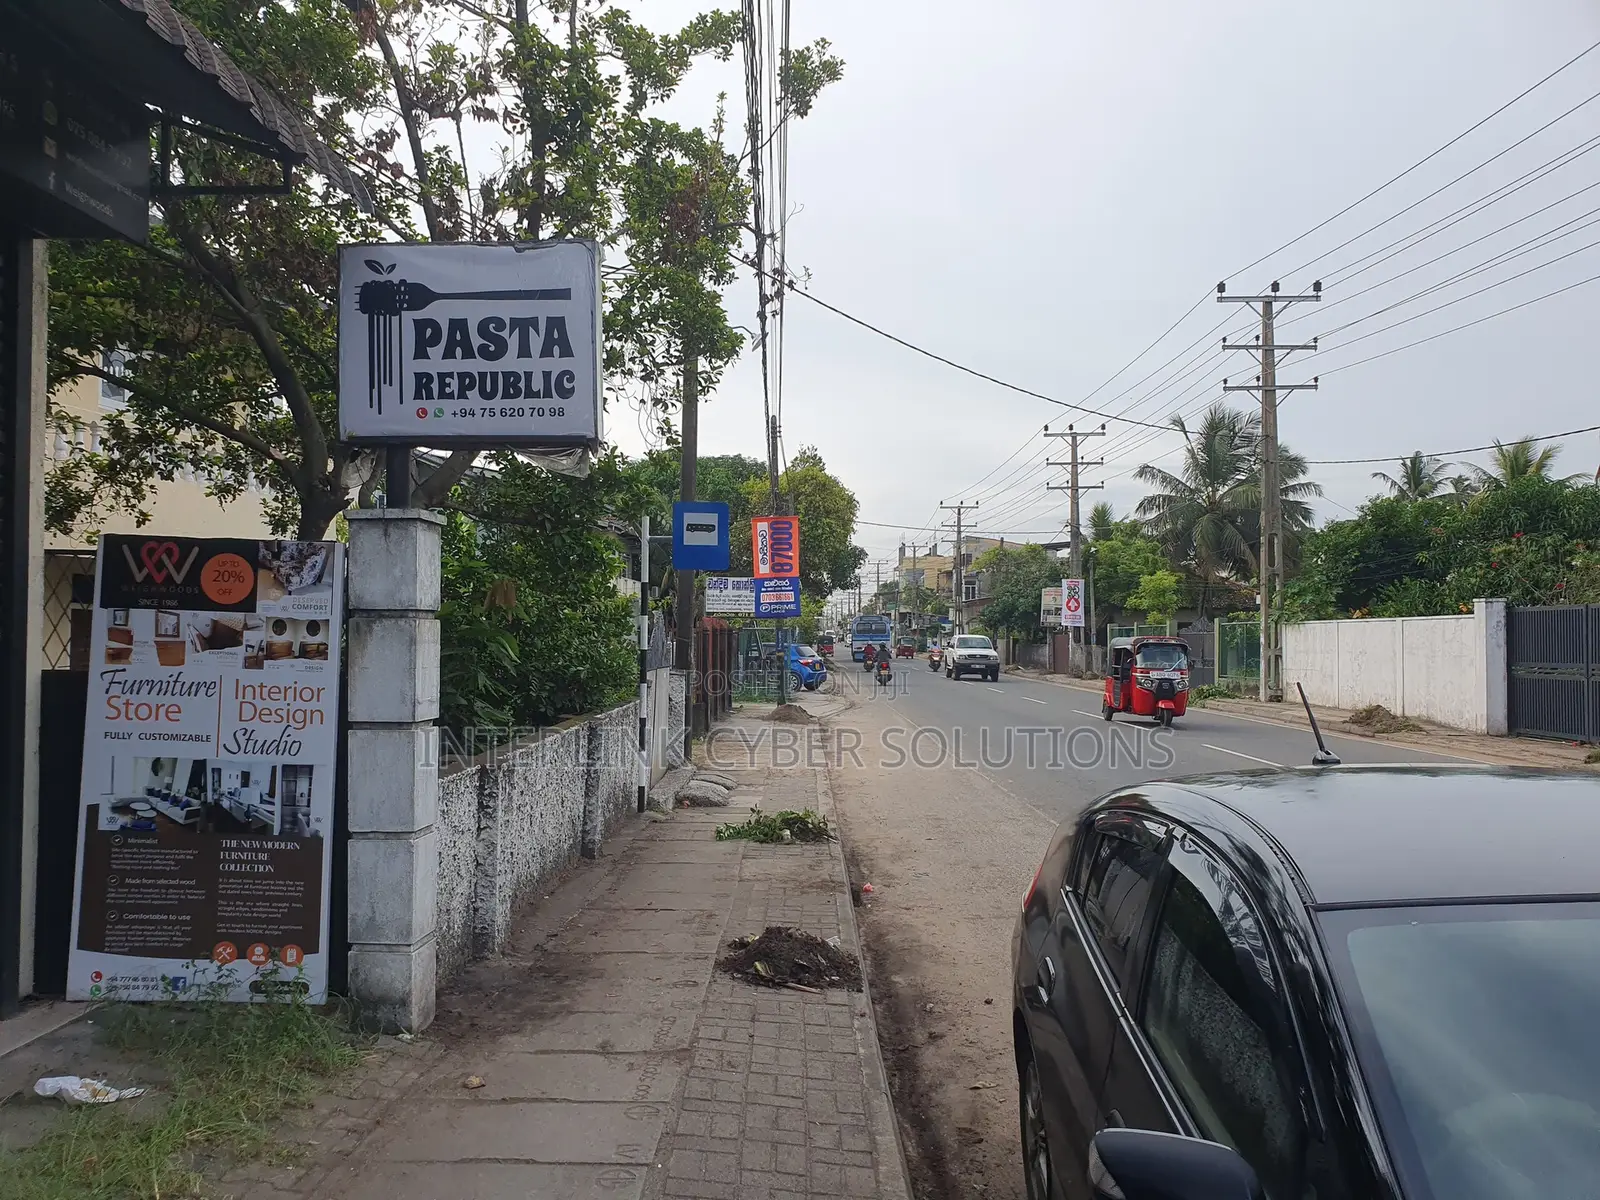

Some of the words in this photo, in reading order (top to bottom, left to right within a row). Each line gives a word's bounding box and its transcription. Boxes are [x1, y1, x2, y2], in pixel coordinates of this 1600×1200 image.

[412, 316, 575, 361] PASTA
[412, 369, 576, 401] REPUBLIC
[451, 407, 476, 418] +94
[480, 407, 496, 418] 75
[500, 407, 525, 418] 620
[529, 407, 545, 418] 70
[548, 406, 565, 417] 98
[770, 521, 793, 573] 87000
[212, 570, 245, 583] 20%
[217, 588, 232, 596] OFF
[292, 603, 329, 611] COMFORT
[100, 668, 217, 698] Furniture
[234, 678, 326, 703] Interior
[104, 694, 182, 722] Store
[238, 701, 325, 730] Design
[104, 731, 133, 741] FULLY
[138, 732, 212, 743] CUSTOMIZABLE
[222, 724, 302, 757] Studio
[221, 840, 240, 848] THE
[241, 840, 260, 848] NEW
[262, 841, 300, 850] MODERN
[220, 851, 270, 860] FURNITURE
[220, 863, 274, 872] COLLECTION
